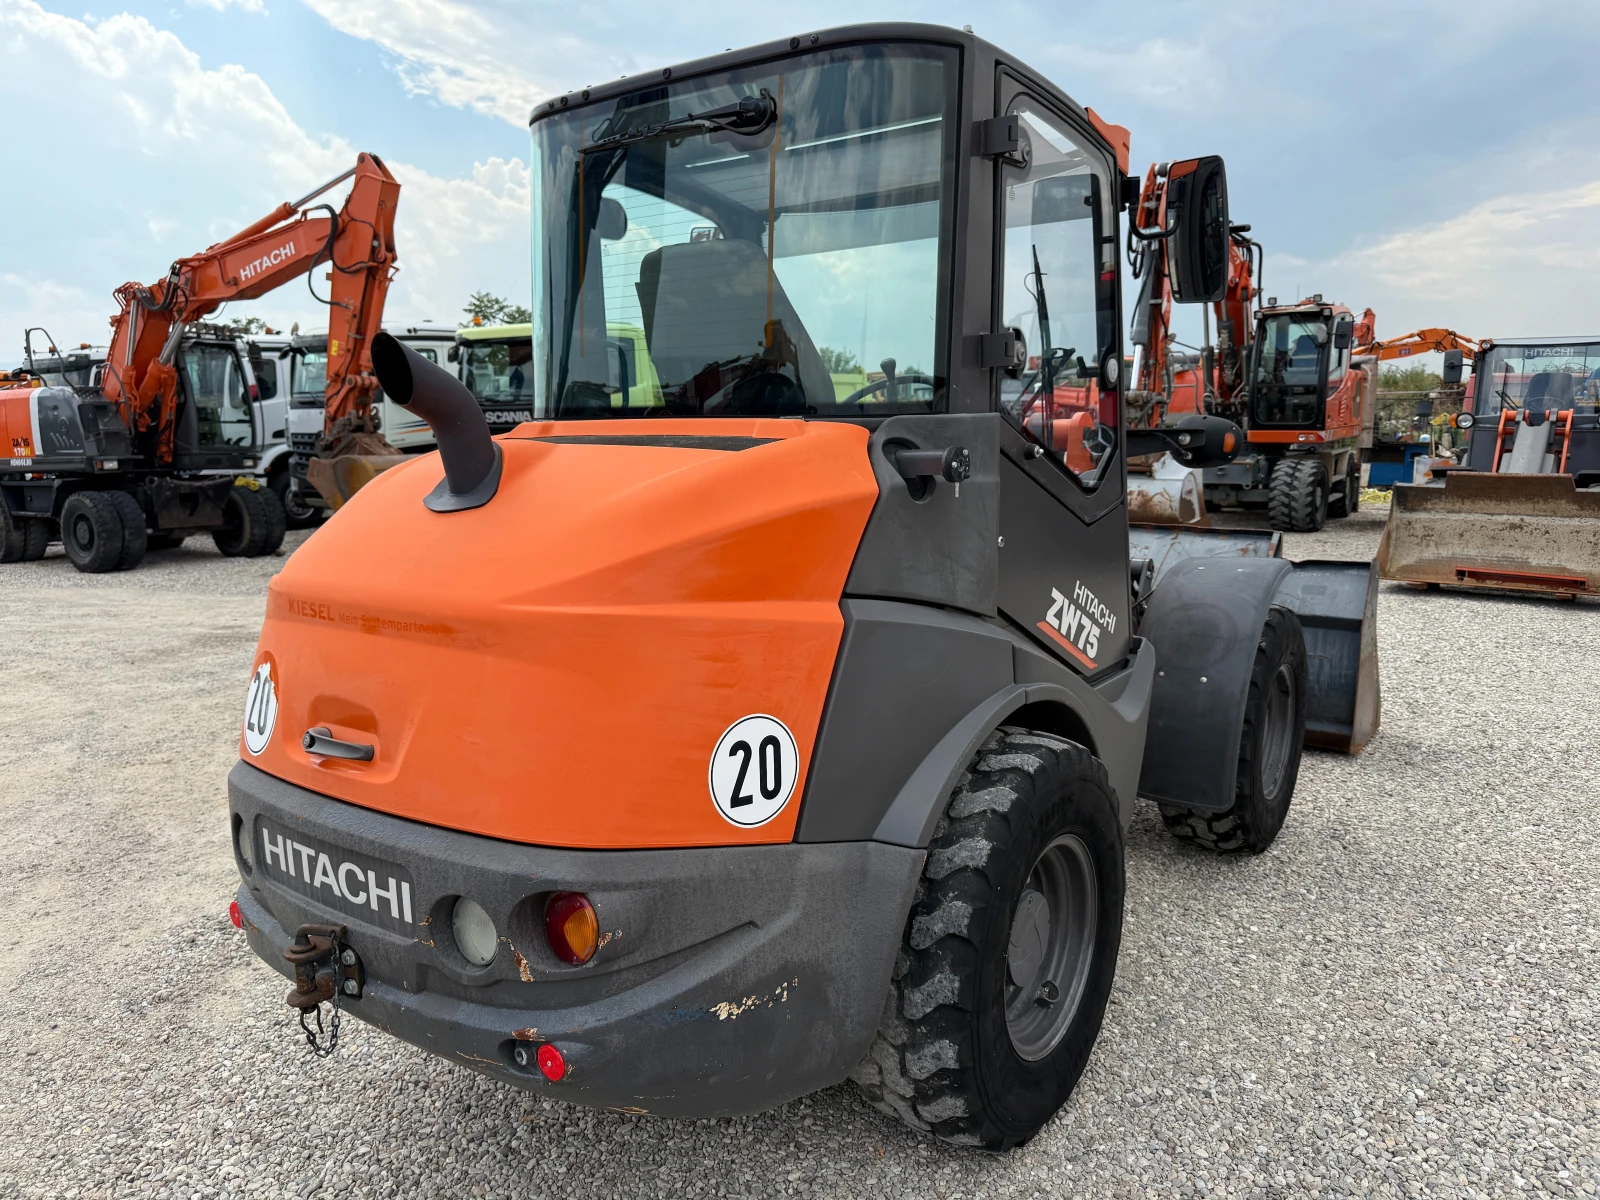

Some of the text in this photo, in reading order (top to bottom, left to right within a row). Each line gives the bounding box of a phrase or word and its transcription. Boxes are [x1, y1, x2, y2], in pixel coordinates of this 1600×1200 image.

[240, 241, 296, 281] HITACHI
[1525, 347, 1574, 357] HITACHI
[485, 411, 532, 423] SCANIA
[288, 598, 335, 622] KIESEL
[338, 612, 360, 627] Mein
[1045, 586, 1101, 659] ZW75
[1073, 580, 1117, 634] HITACHI
[247, 671, 273, 736] 20
[729, 735, 782, 809] 20
[262, 828, 413, 924] HITACHI
